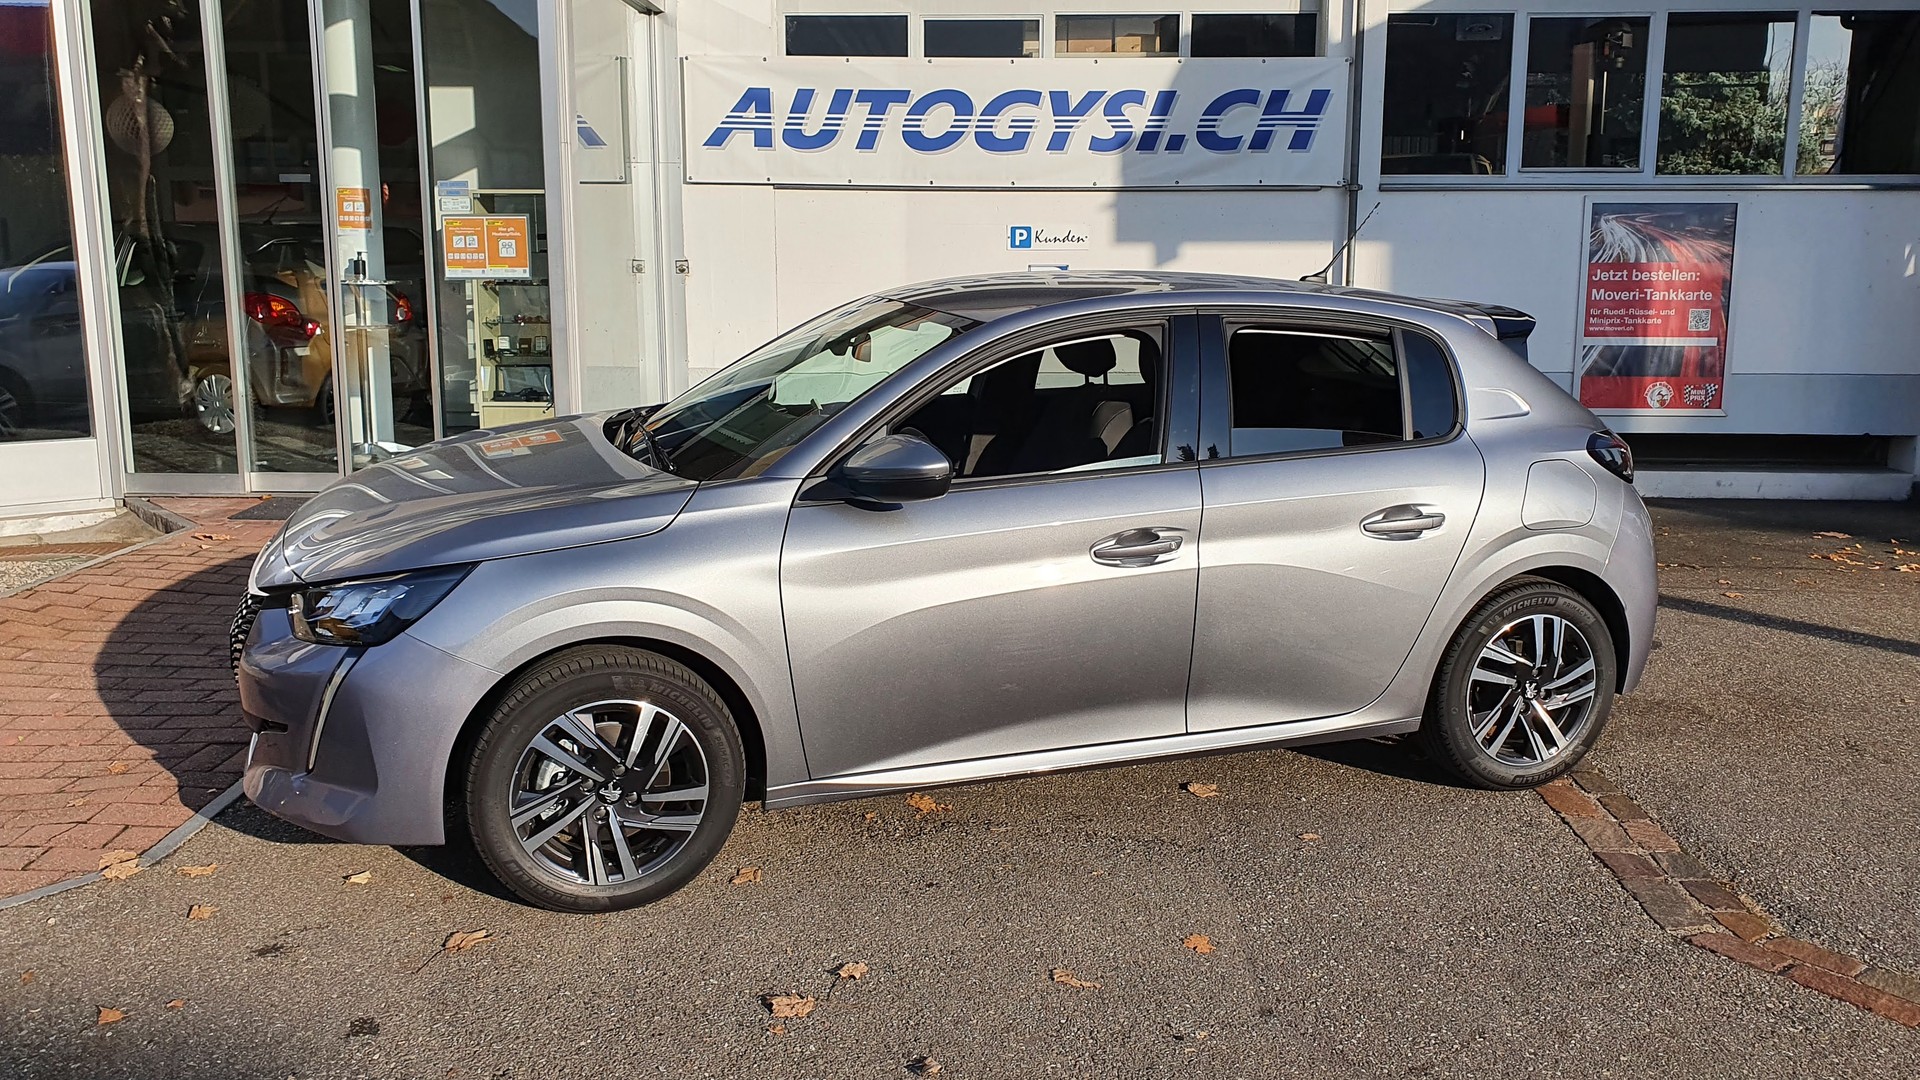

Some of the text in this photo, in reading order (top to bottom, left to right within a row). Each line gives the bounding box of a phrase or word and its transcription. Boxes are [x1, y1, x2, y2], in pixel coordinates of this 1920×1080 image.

[703, 87, 1332, 153] AUTOGYSI.CH
[1015, 229, 1085, 246] P Kunden
[1592, 269, 1701, 282] Jetzt bestellen:
[1591, 288, 1713, 302] Moveri-Tankkarte
[1590, 308, 1676, 316] für Ruedi-Rüssel- und
[1589, 317, 1662, 325] Miniprix-Tankkarte
[1503, 597, 1557, 617] MICHELIN
[648, 681, 715, 731] MICHELIN
[1514, 763, 1566, 784] MICHELIN
